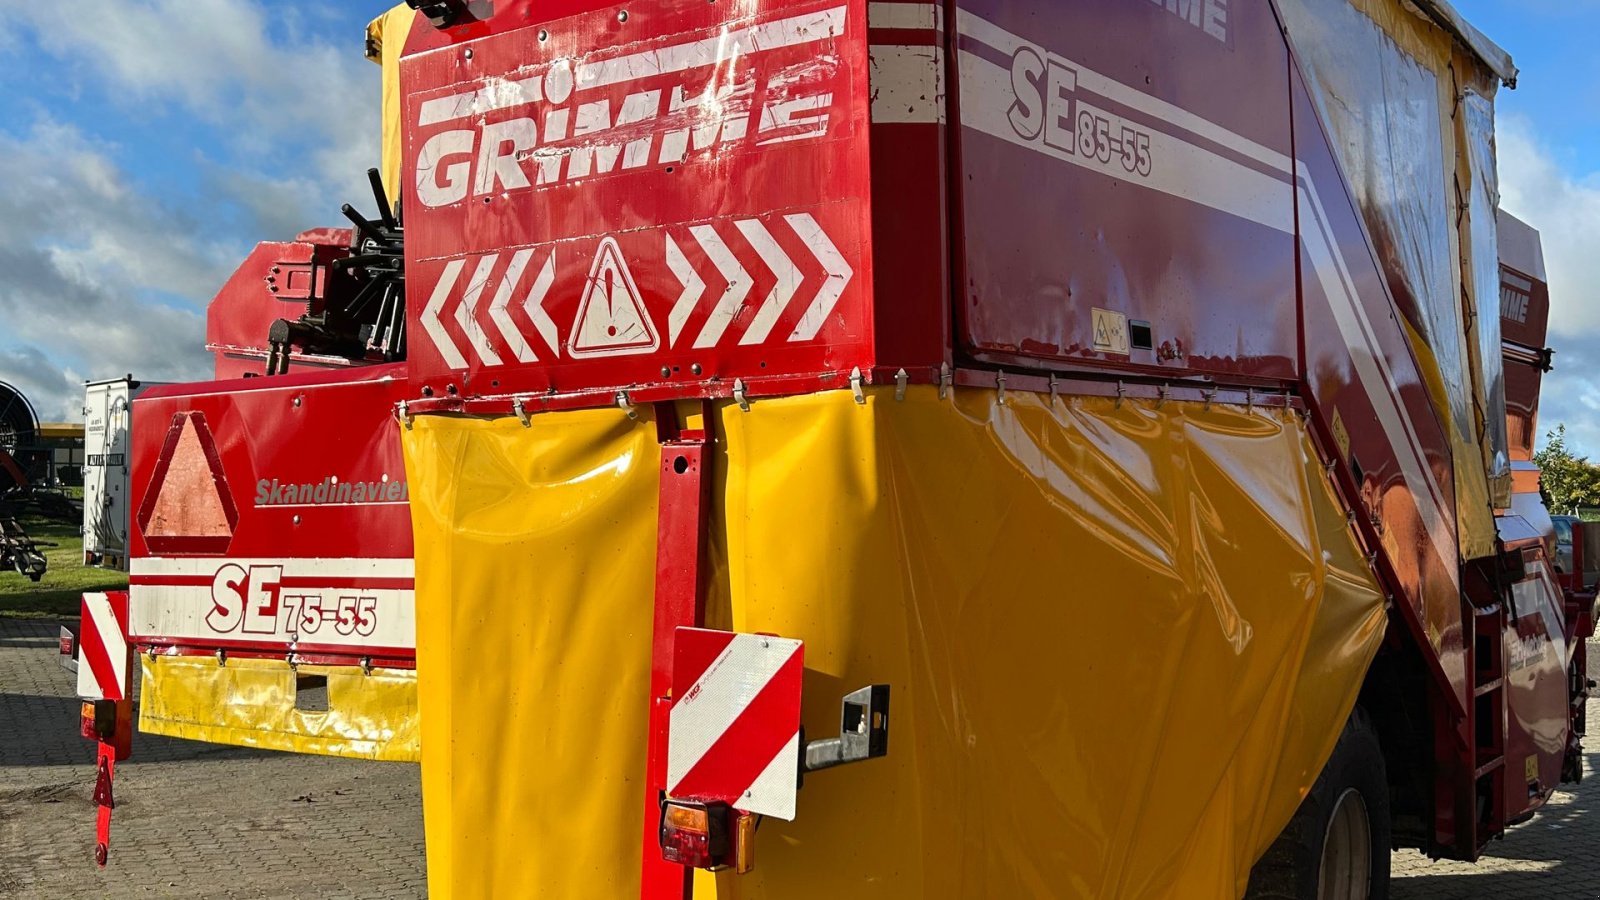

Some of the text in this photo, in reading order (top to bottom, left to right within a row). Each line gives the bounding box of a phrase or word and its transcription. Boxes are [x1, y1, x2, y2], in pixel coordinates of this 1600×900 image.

[1007, 46, 1152, 177] SE 85-55
[205, 562, 378, 637] SE 75-55
